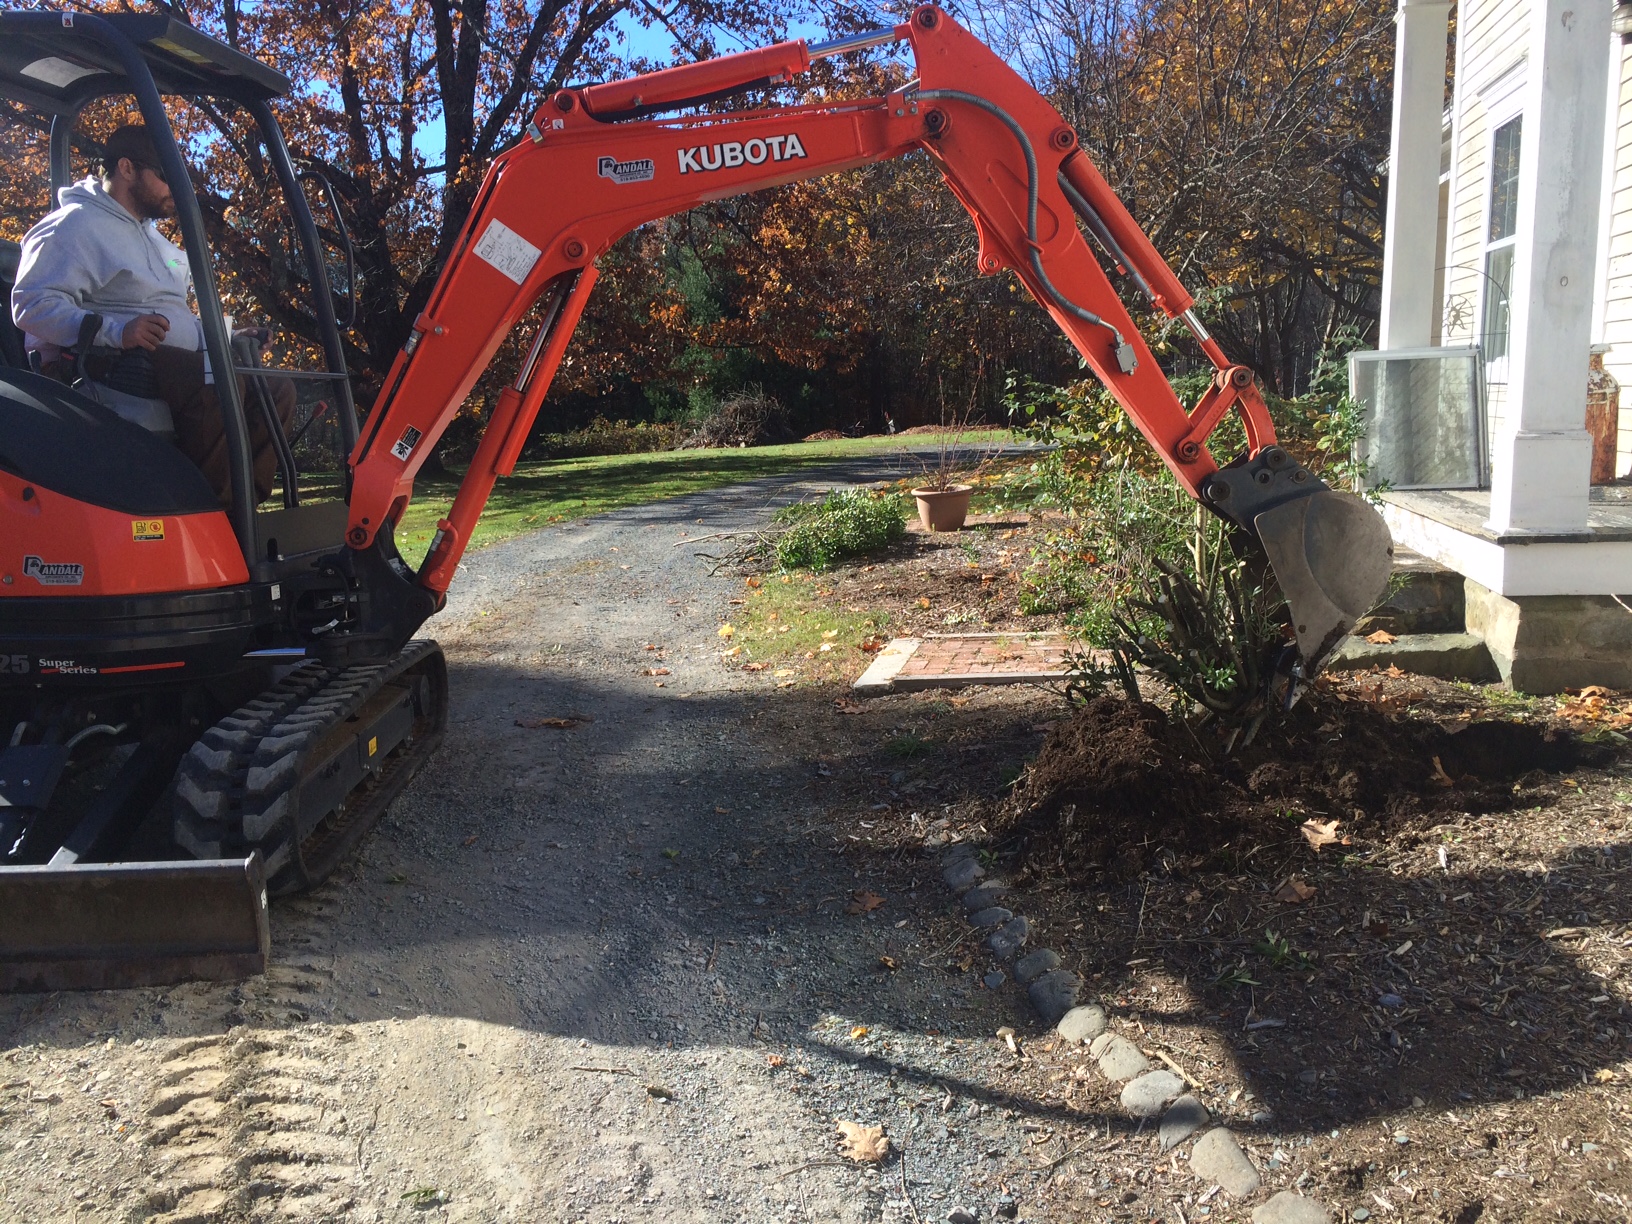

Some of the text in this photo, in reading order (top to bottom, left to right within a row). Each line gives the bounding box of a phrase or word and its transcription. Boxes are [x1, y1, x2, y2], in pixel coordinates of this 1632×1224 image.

[678, 134, 806, 174] KUBOTA
[598, 157, 653, 176] RANDALL
[24, 556, 83, 575] RANDALL
[38, 658, 75, 668] Super
[59, 665, 97, 674] Series
